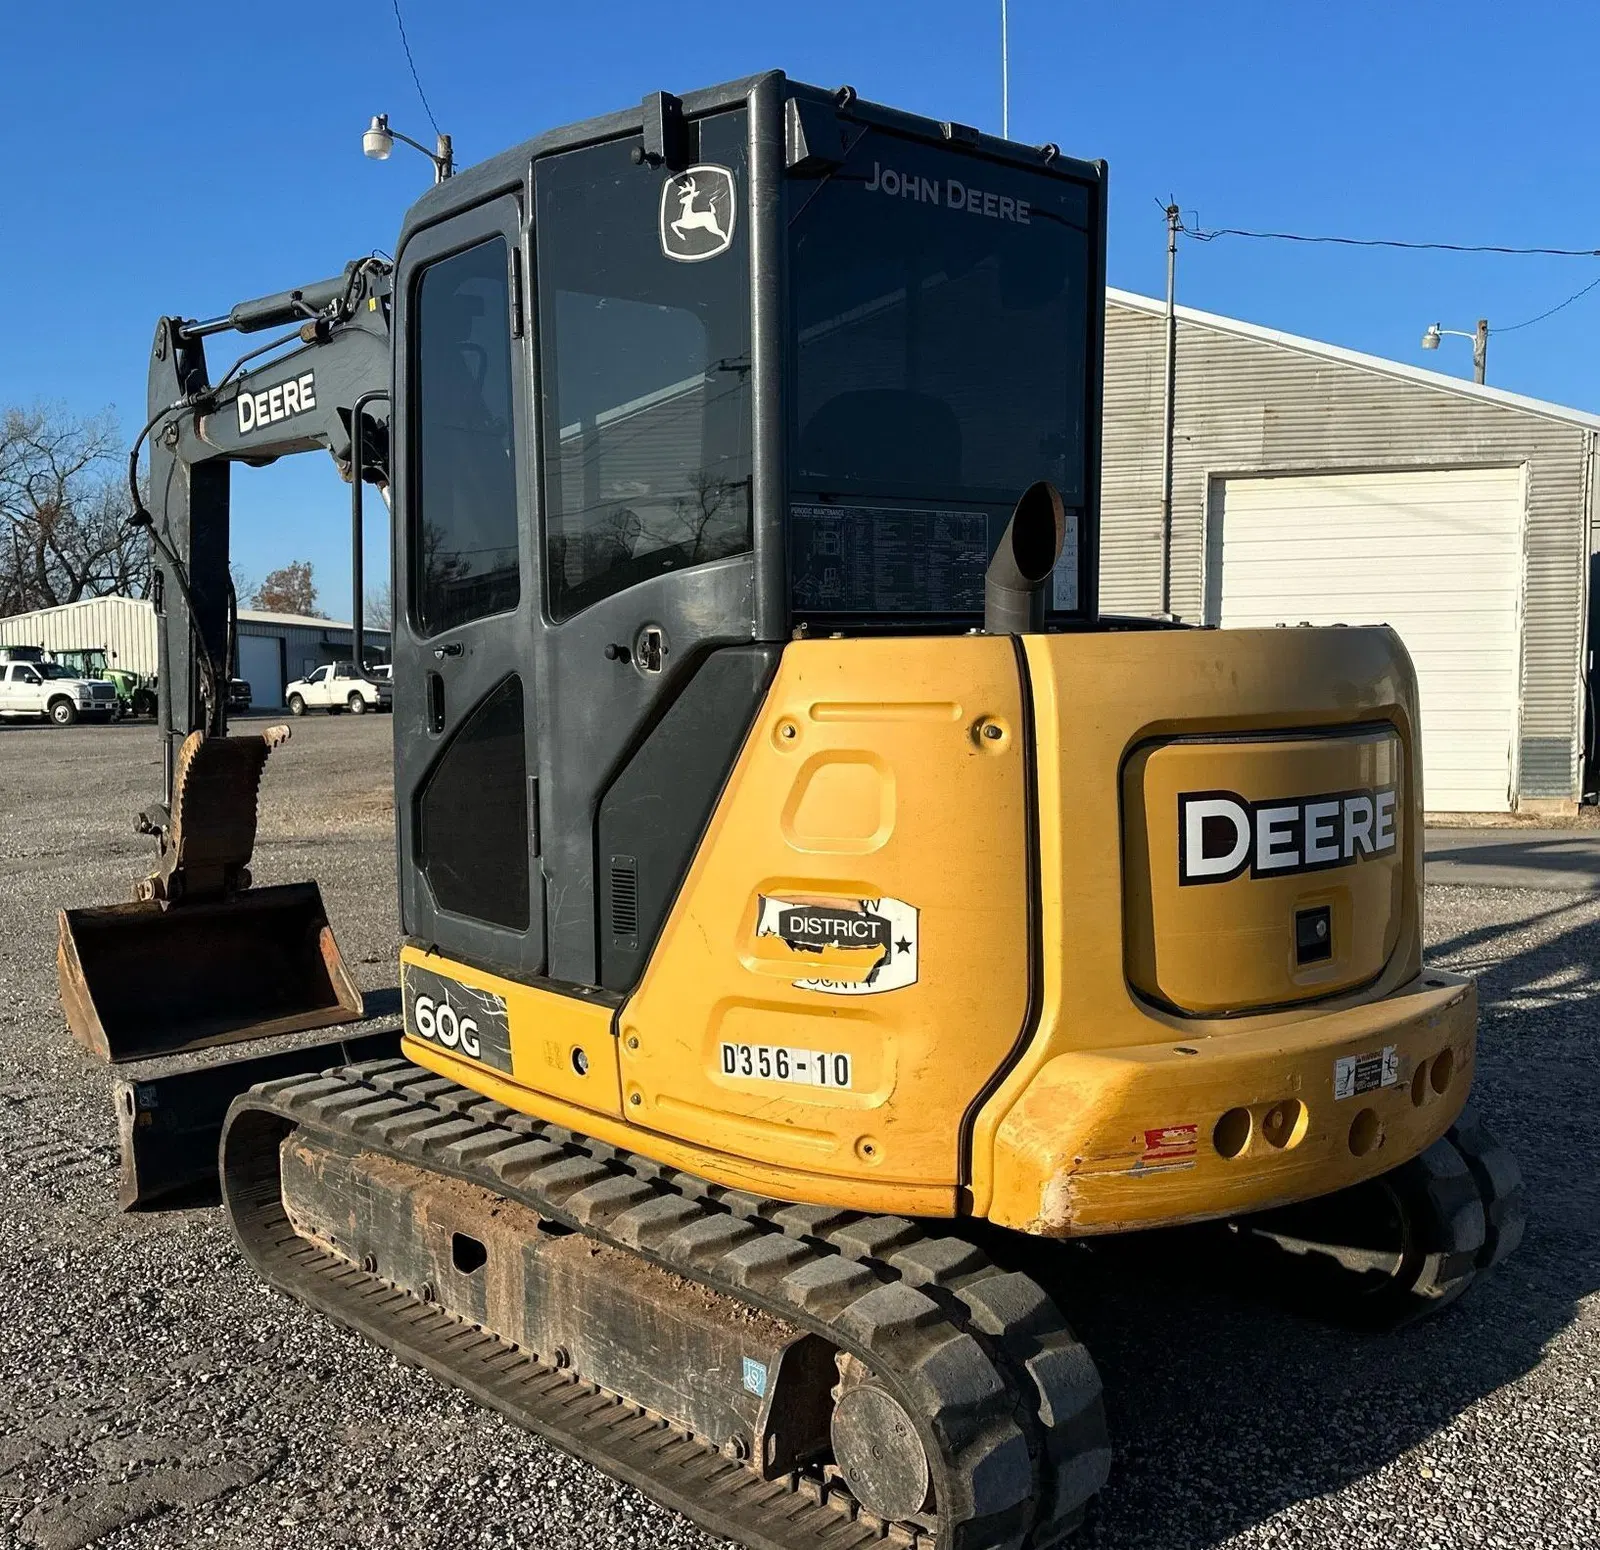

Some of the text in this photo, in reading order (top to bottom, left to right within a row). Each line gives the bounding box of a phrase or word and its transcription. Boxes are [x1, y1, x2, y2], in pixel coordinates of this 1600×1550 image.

[864, 160, 1031, 225] JOHN DEERE
[237, 372, 316, 433] DEERE
[1185, 790, 1396, 877] DEERE
[789, 916, 881, 939] DISTRICT
[415, 996, 480, 1057] 60G
